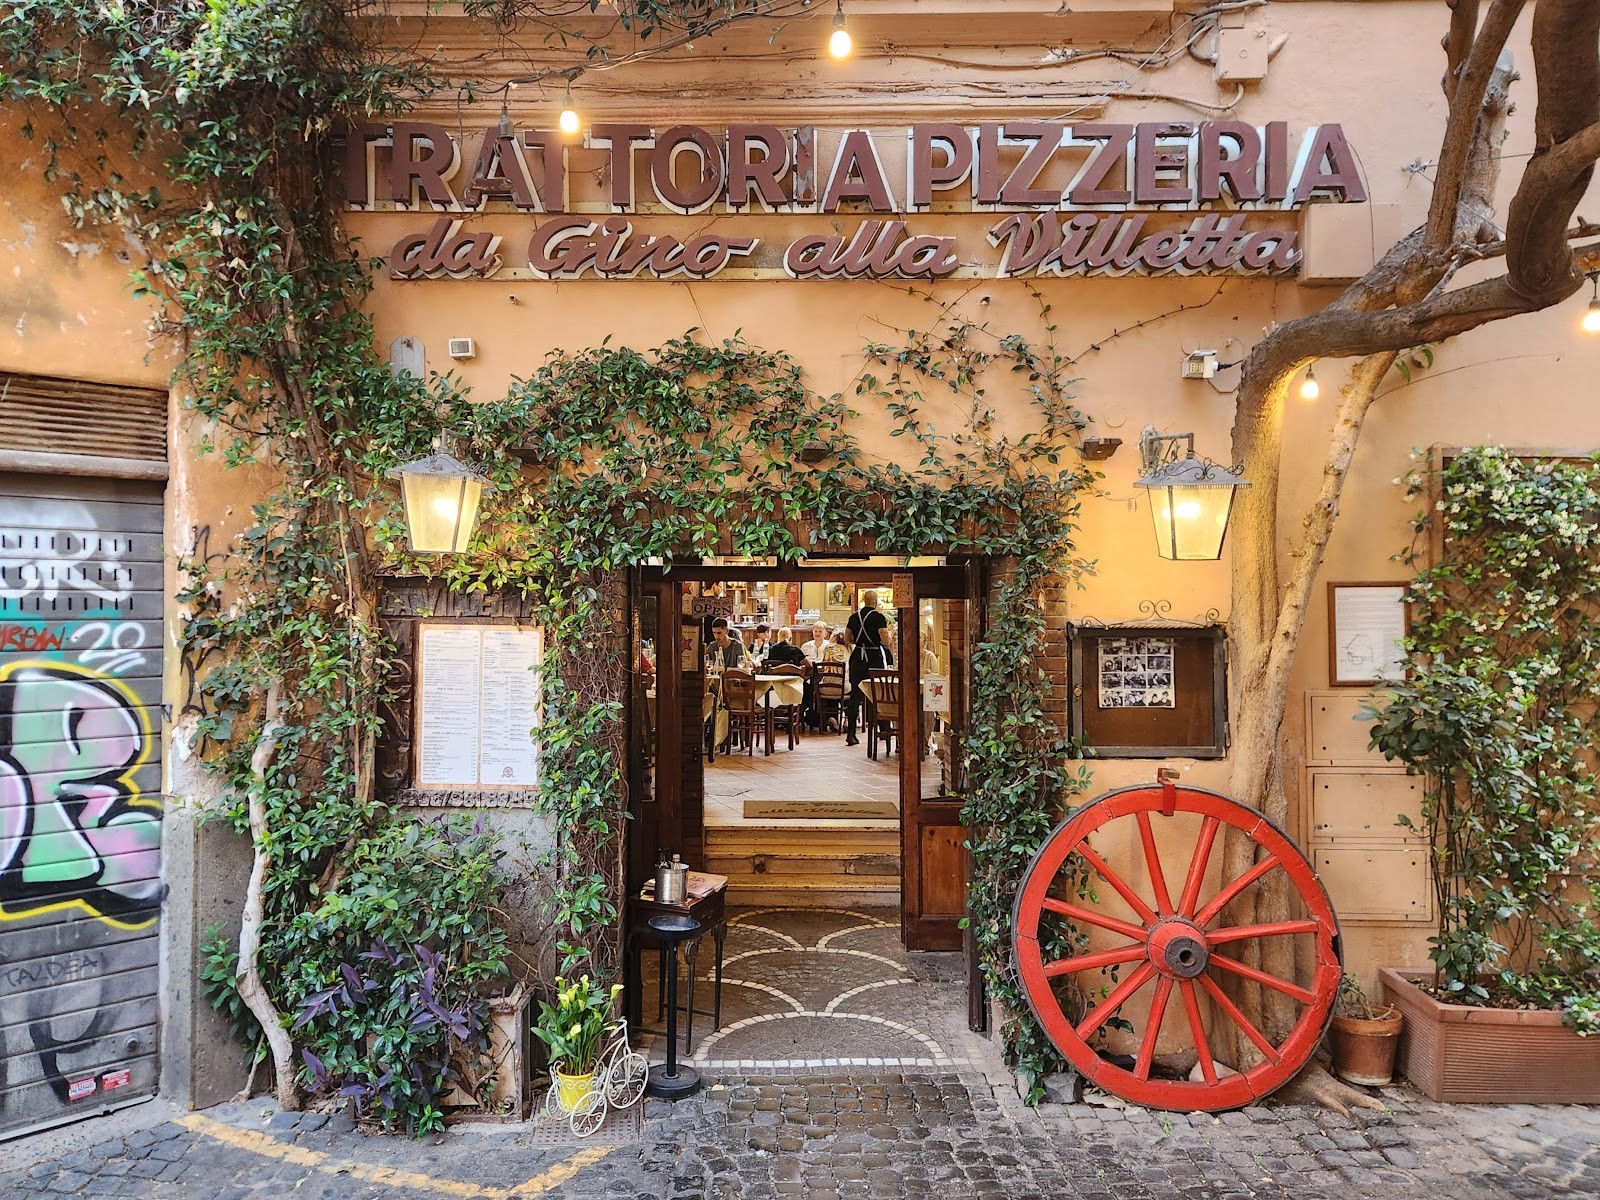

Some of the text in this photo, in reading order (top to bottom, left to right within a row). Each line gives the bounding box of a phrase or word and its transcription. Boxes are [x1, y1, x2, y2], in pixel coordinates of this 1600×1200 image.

[331, 121, 1368, 213] TRATTORIA PIZZERIA
[391, 208, 1302, 279] da Gino alla Villetta
[693, 604, 732, 616] OPEN
